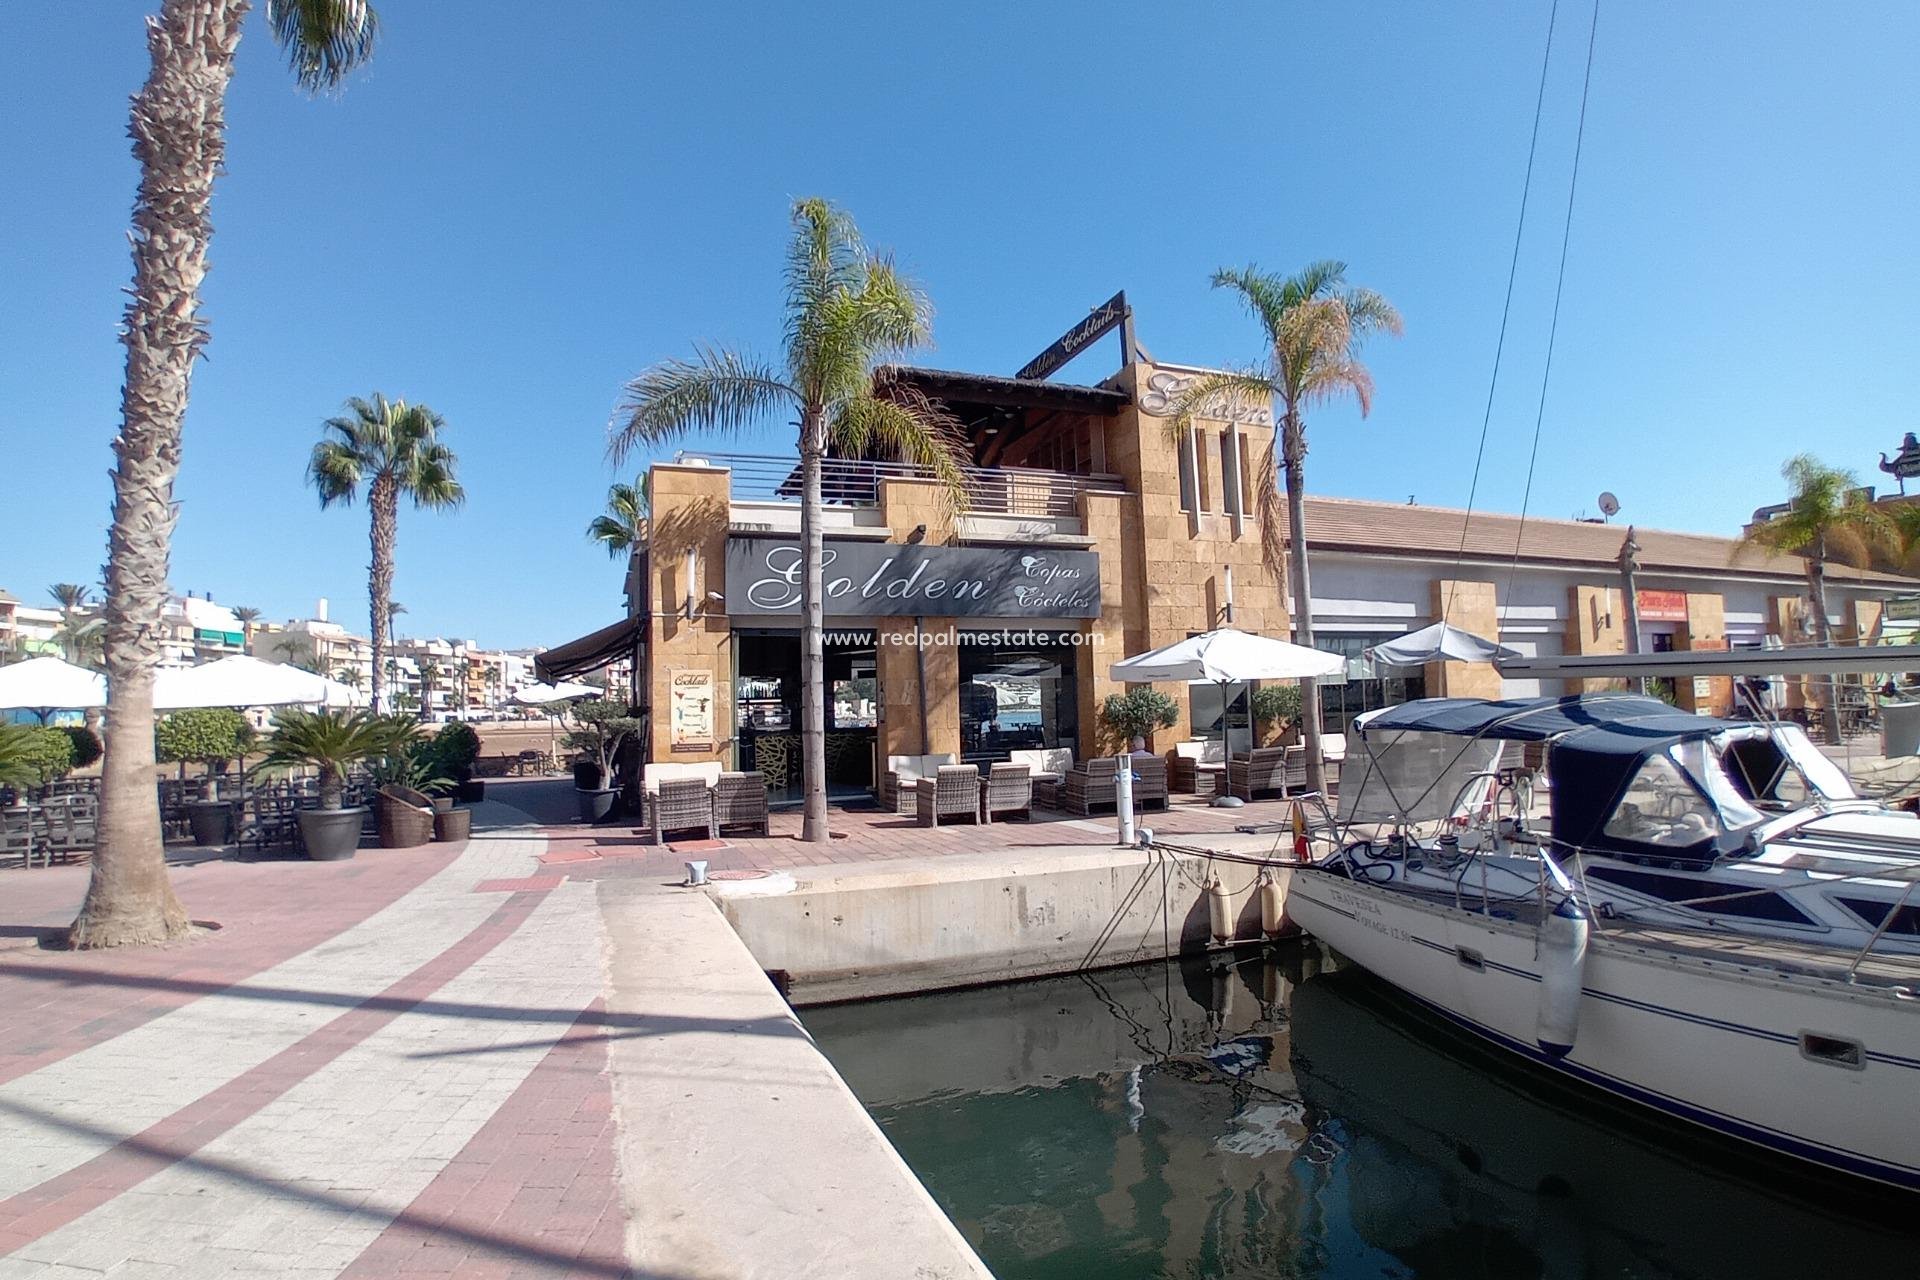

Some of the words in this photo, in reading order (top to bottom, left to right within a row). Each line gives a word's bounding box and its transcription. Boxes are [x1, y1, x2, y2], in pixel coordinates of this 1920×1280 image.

[1062, 302, 1114, 353] Cocktails
[747, 546, 990, 609] Golden
[1021, 555, 1080, 585] Copas
[1014, 585, 1089, 608] Cócteles
